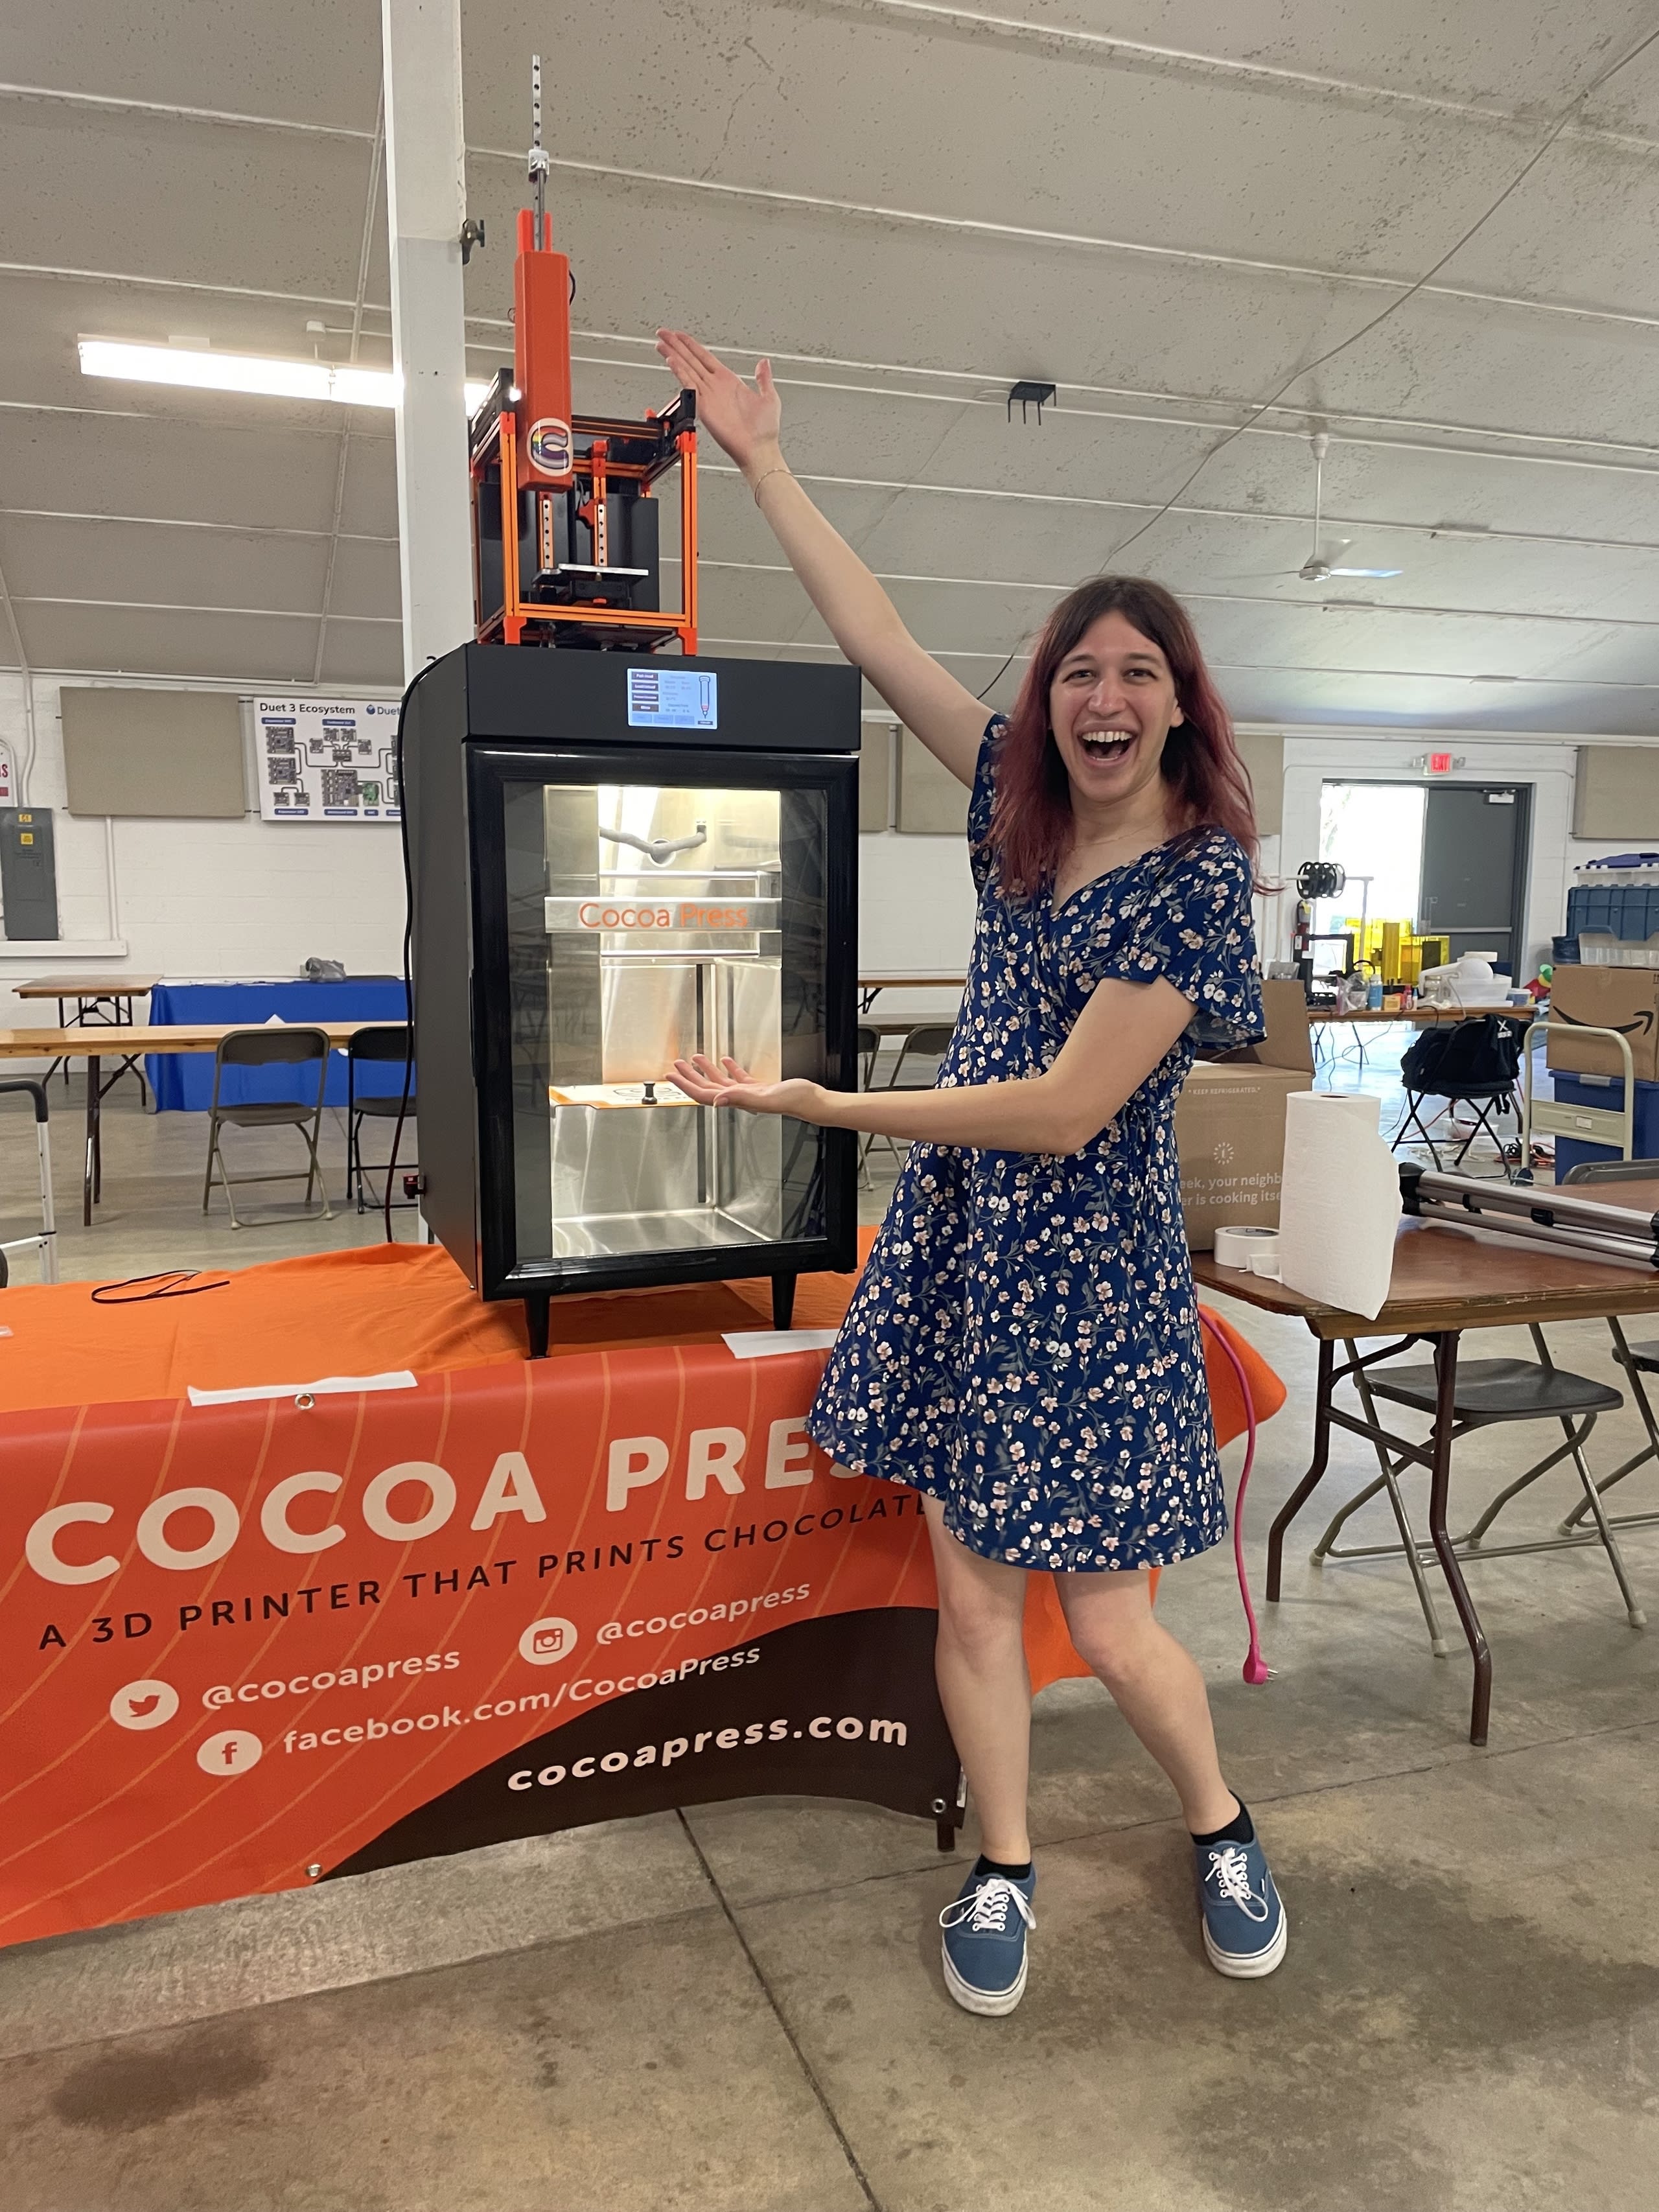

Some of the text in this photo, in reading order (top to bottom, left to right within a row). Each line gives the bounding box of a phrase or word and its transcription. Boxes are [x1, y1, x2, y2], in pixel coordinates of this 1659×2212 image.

[259, 703, 355, 716] Duet 3 Ecosystem
[377, 706, 400, 716] Duet
[579, 902, 748, 928] Cocoa Press
[1180, 1172, 1281, 1191] eek, your neighb
[1181, 1189, 1281, 1206] er is cooking itse
[25, 1416, 863, 1585] COCOA PRE
[38, 1624, 67, 1651] A
[92, 1612, 152, 1644] 3D
[179, 1580, 381, 1631] PRINTER
[403, 1559, 517, 1600] THAT
[538, 1535, 685, 1579] PRINTS
[596, 1582, 811, 1645] @cocoapress
[202, 1651, 461, 1711] @cocoapress
[283, 1645, 761, 1754] facebook.com/CocoaPress
[507, 1716, 907, 1791] cocoapress.com
